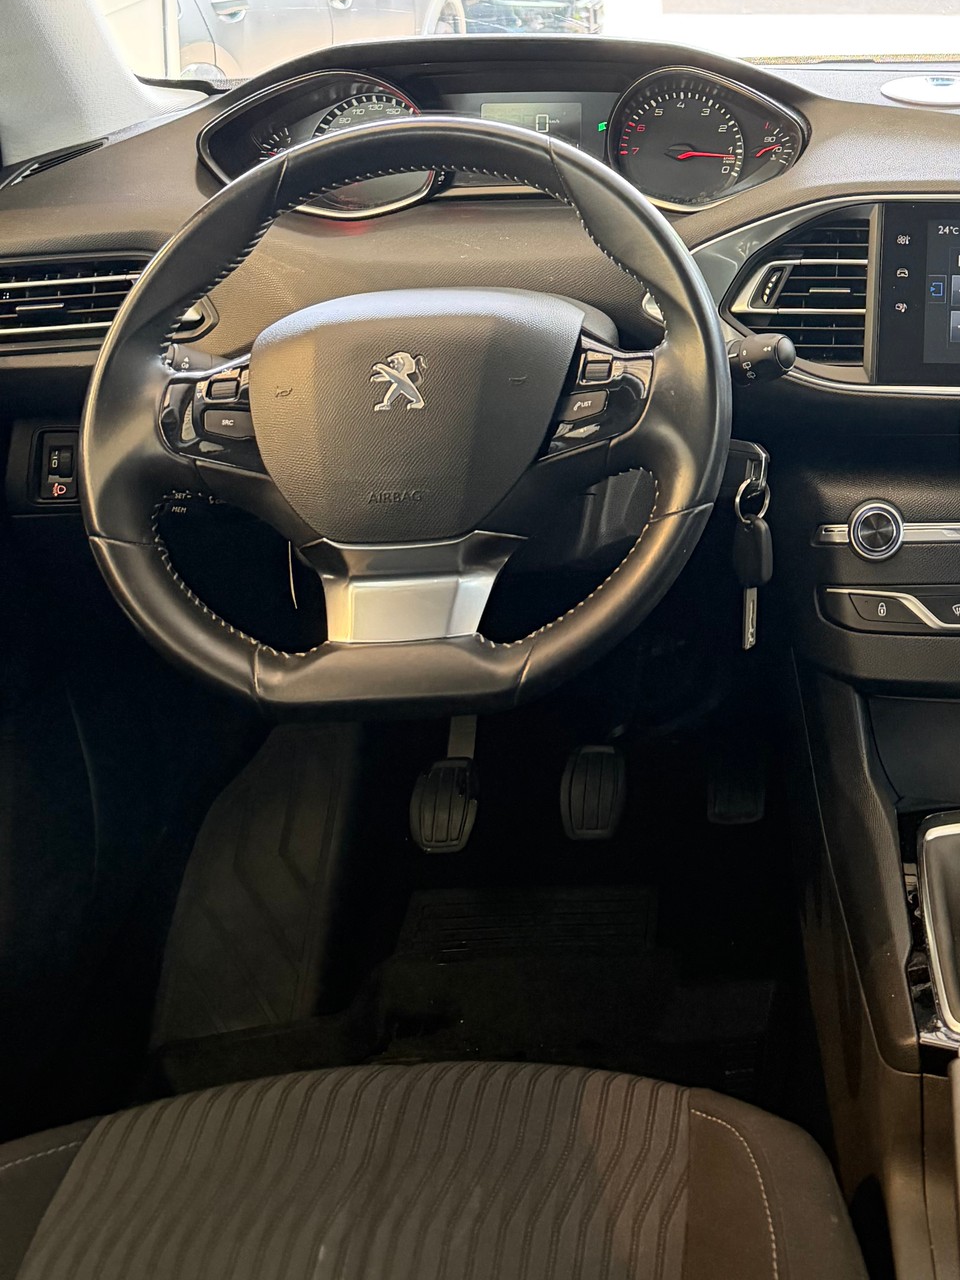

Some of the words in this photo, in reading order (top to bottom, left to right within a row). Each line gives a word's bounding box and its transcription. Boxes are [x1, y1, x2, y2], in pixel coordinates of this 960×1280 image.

[654, 108, 664, 116] 5
[701, 108, 710, 116] 3
[536, 114, 549, 132] 0
[636, 124, 646, 132] 6
[718, 125, 728, 133] 2
[631, 147, 640, 155] 7
[728, 146, 733, 154] 1
[721, 165, 730, 174] 0
[938, 226, 959, 235] 24°C
[368, 490, 422, 504] AIRBAG
